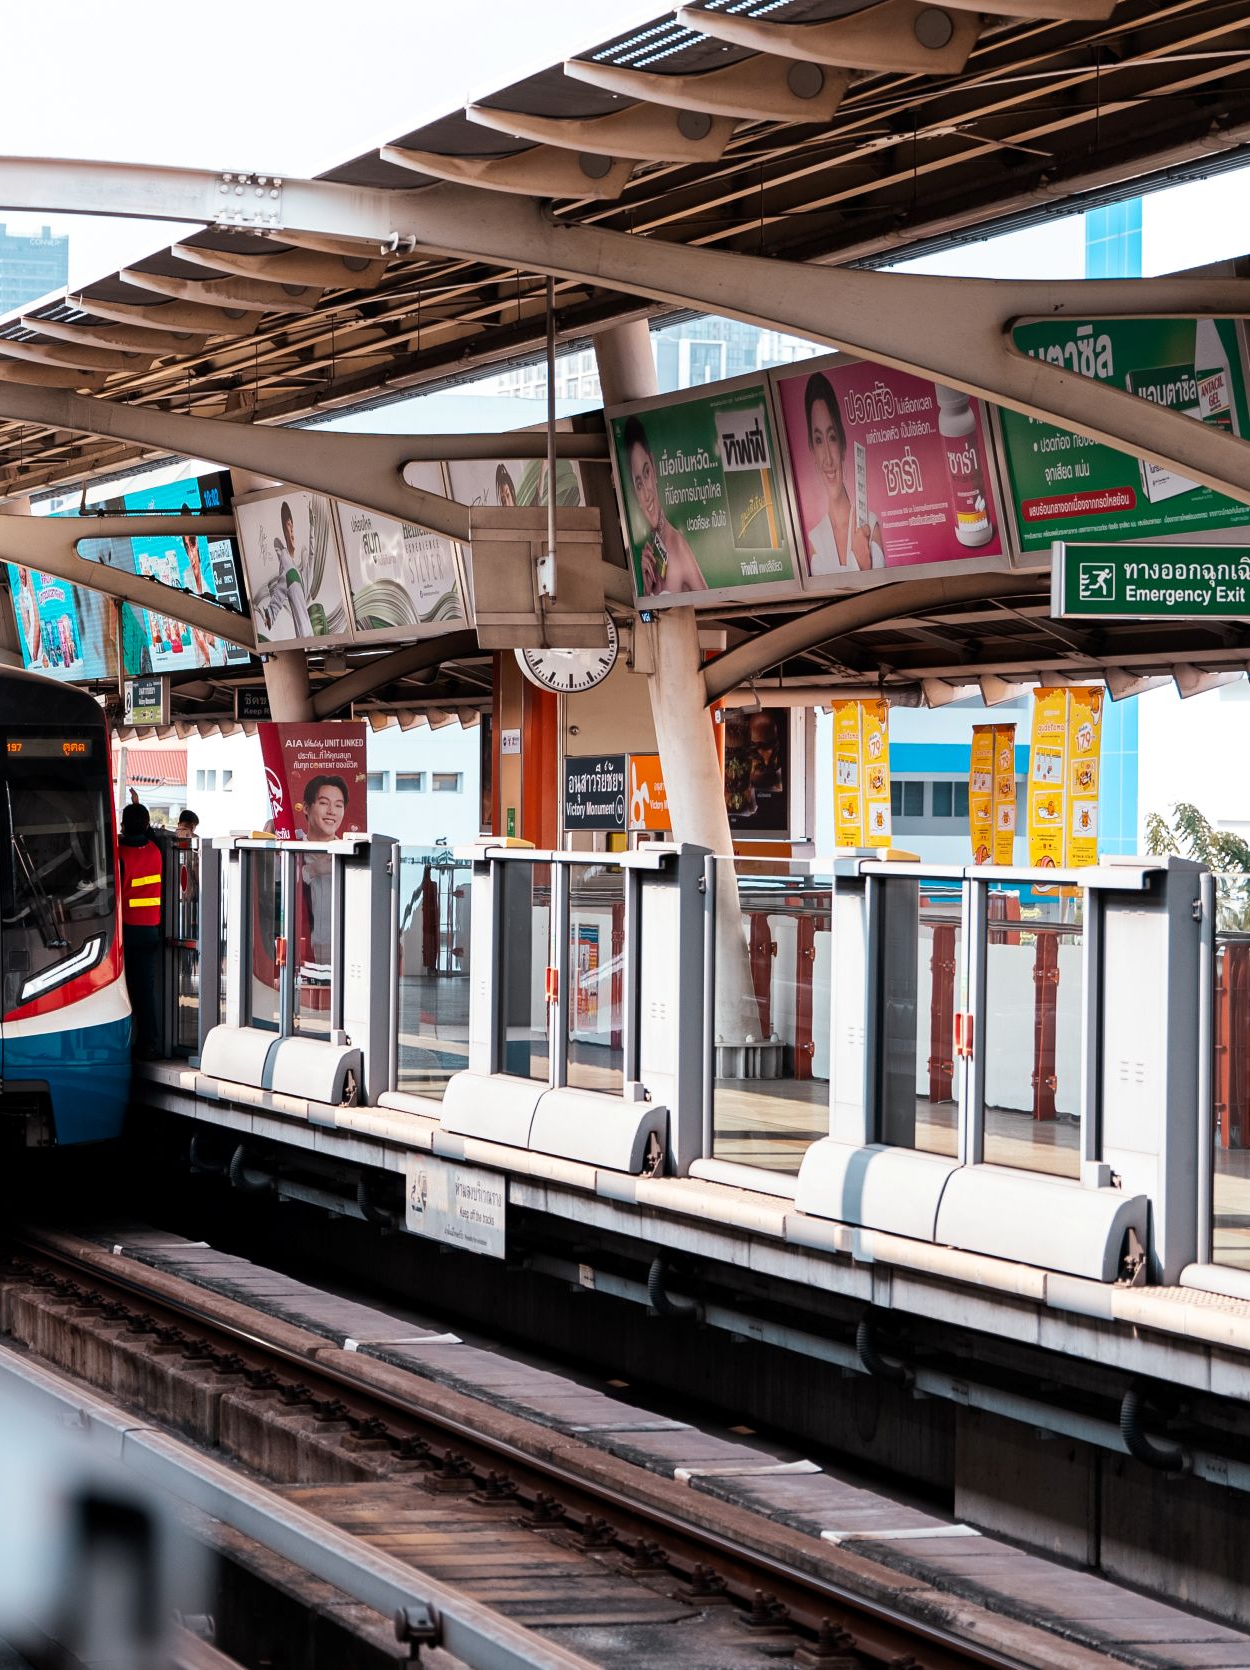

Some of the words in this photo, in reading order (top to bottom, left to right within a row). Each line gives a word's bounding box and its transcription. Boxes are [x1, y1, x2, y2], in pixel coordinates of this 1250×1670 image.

[844, 381, 895, 426] ปวดหัว
[722, 417, 767, 467] ทิฟฟี่
[882, 446, 923, 496] ซาร่า
[947, 442, 978, 475] ซาร่า
[408, 553, 444, 584] SILVER
[1123, 556, 1250, 588] ทางออกฉุกเฉิ
[1125, 585, 1211, 606] Emergency
[1216, 586, 1246, 602] Exit
[7, 743, 22, 752] 197
[285, 739, 303, 748] AIA
[324, 739, 340, 748] UNIT
[340, 739, 364, 748] LINKED
[568, 760, 624, 803] อนุสาวรีย์ชัยฯ
[566, 802, 586, 819] Victory
[586, 802, 615, 816] Monument
